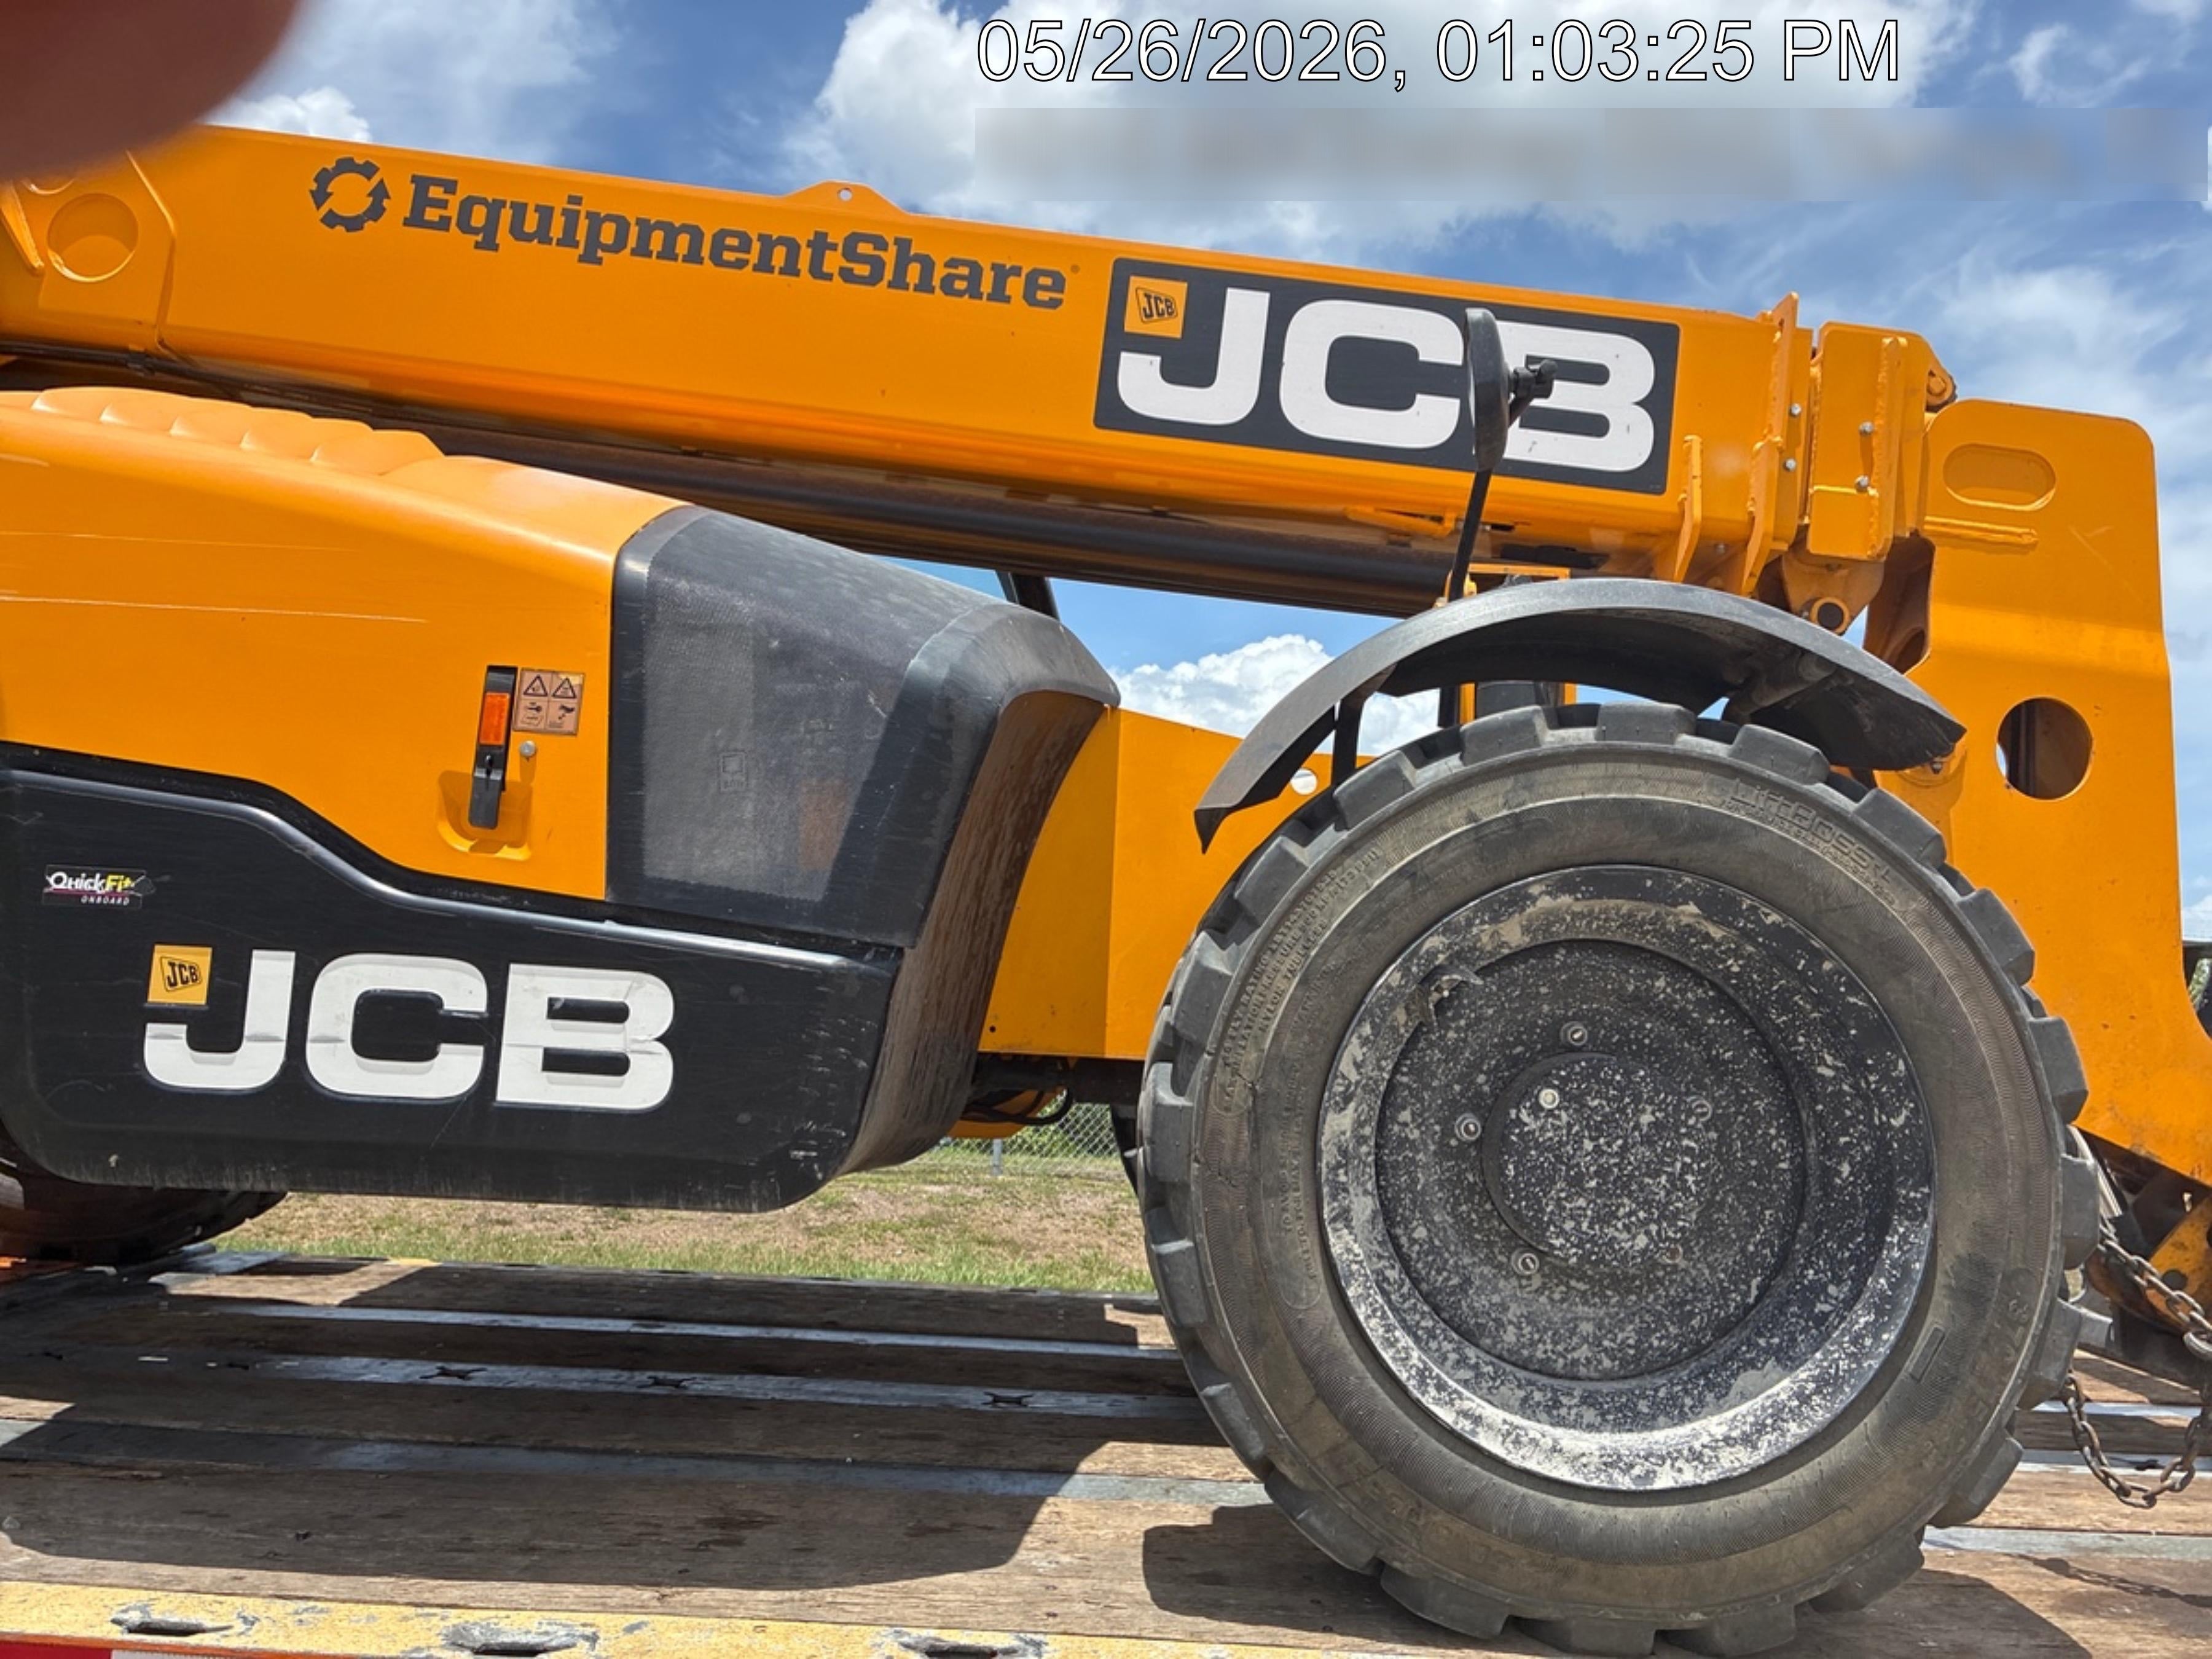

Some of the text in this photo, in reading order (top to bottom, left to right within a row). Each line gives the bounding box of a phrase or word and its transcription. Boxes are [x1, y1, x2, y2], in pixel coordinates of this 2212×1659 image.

[402, 173, 1067, 311] EquipmentShare
[1142, 292, 1175, 319] JCB
[1117, 287, 1655, 473] JCB
[80, 895, 130, 906] ONBOARD
[167, 960, 198, 987] JCB
[143, 949, 674, 1111] JCB
